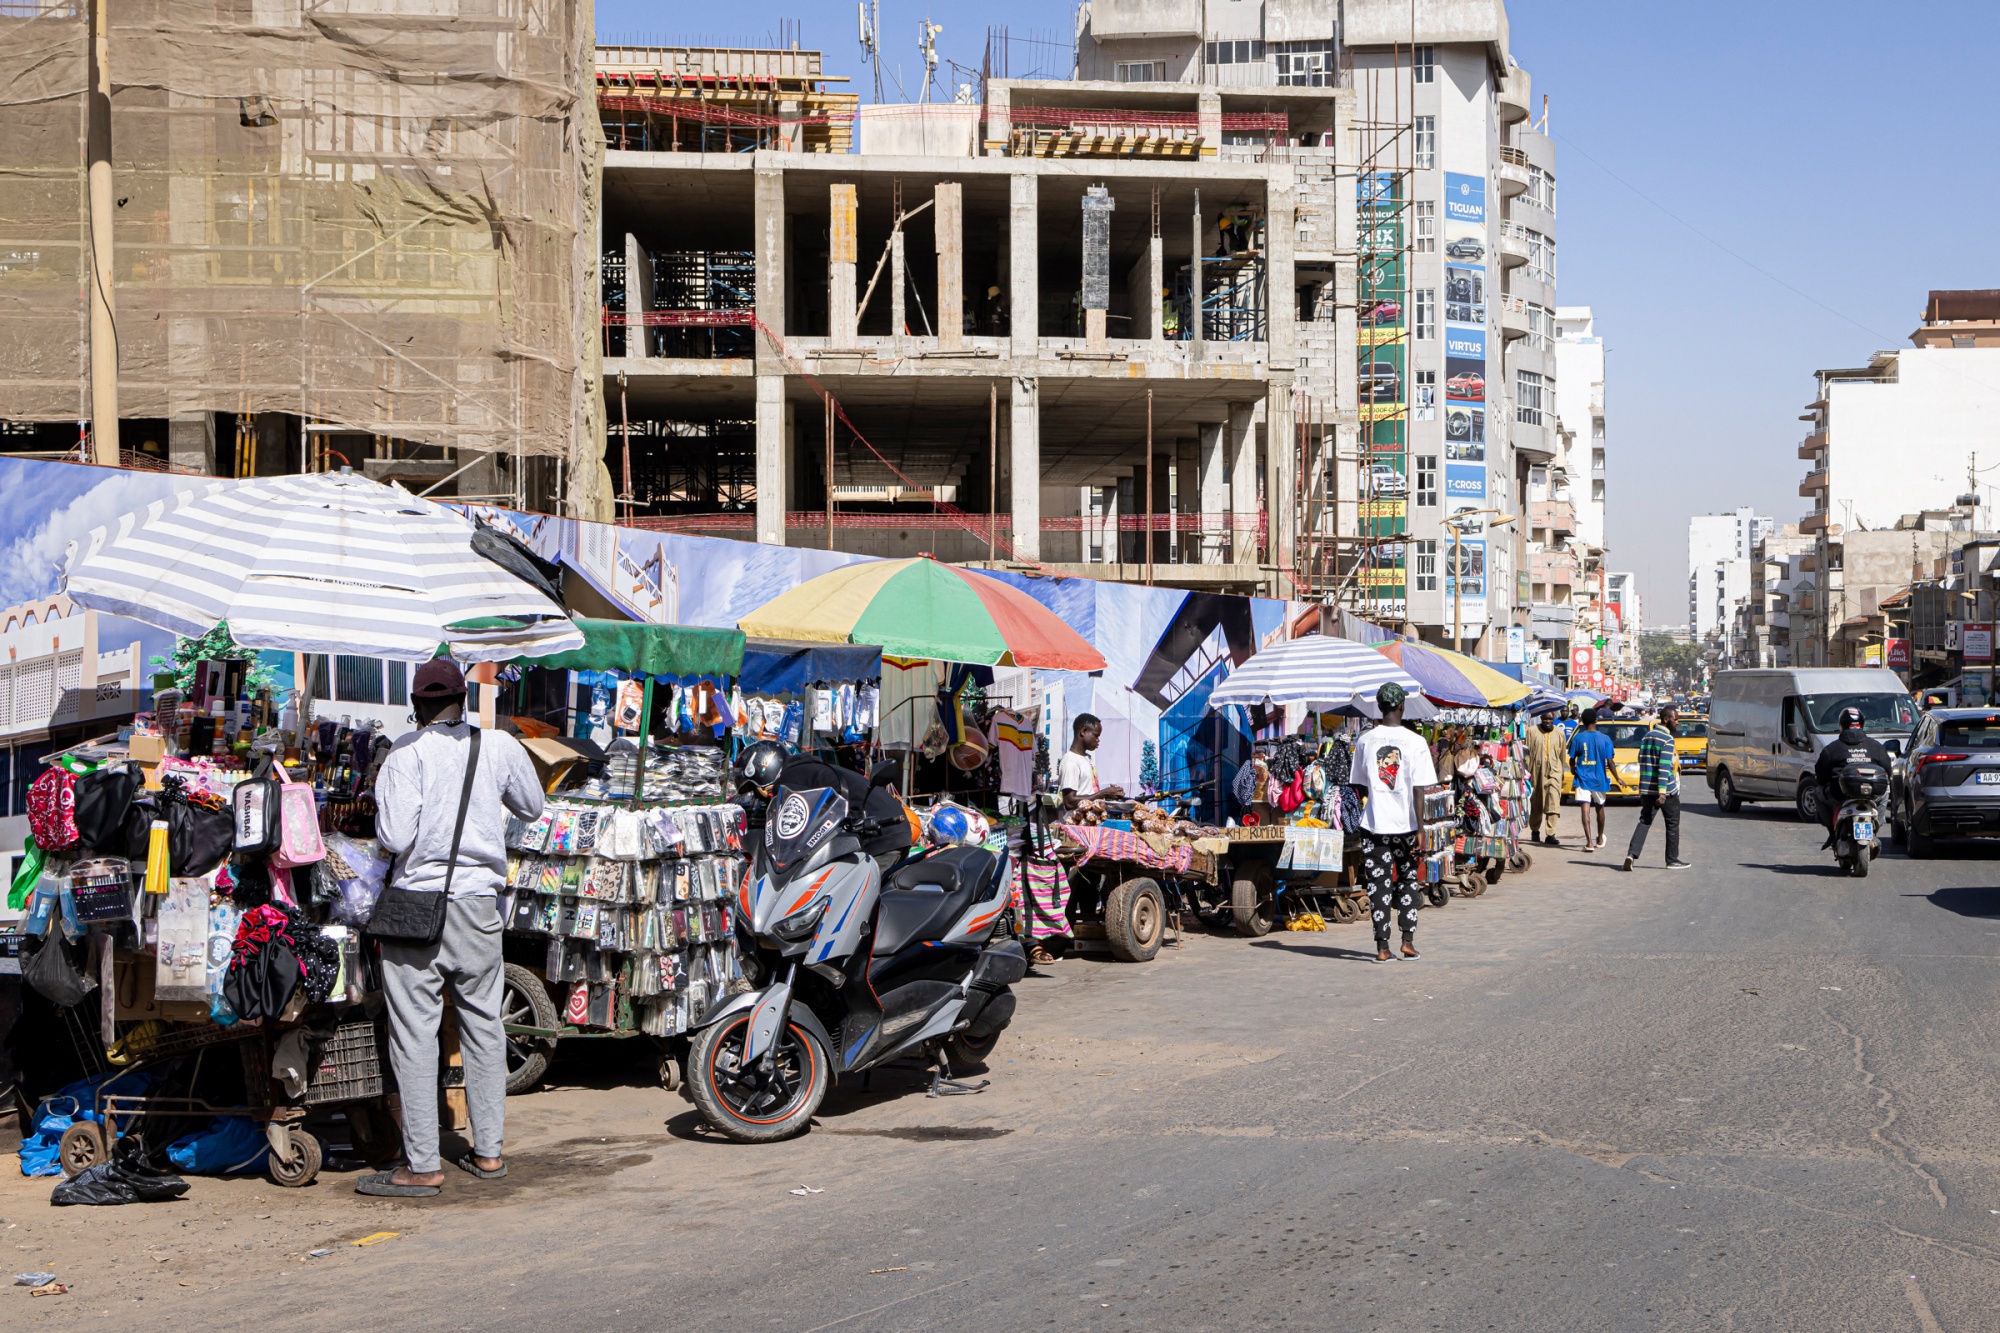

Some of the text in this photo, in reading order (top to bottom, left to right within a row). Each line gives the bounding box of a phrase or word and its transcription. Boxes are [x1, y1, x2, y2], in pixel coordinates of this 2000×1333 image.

[1448, 201, 1482, 215] TIGUAN
[1448, 340, 1482, 353] VIRTUS
[1447, 479, 1482, 490] T-CROSS
[1381, 604, 1392, 612] 65
[1576, 665, 1588, 673] LG
[1983, 773, 1993, 781] AA
[244, 790, 253, 838] WASHBAG
[808, 825, 828, 846] IPONE
